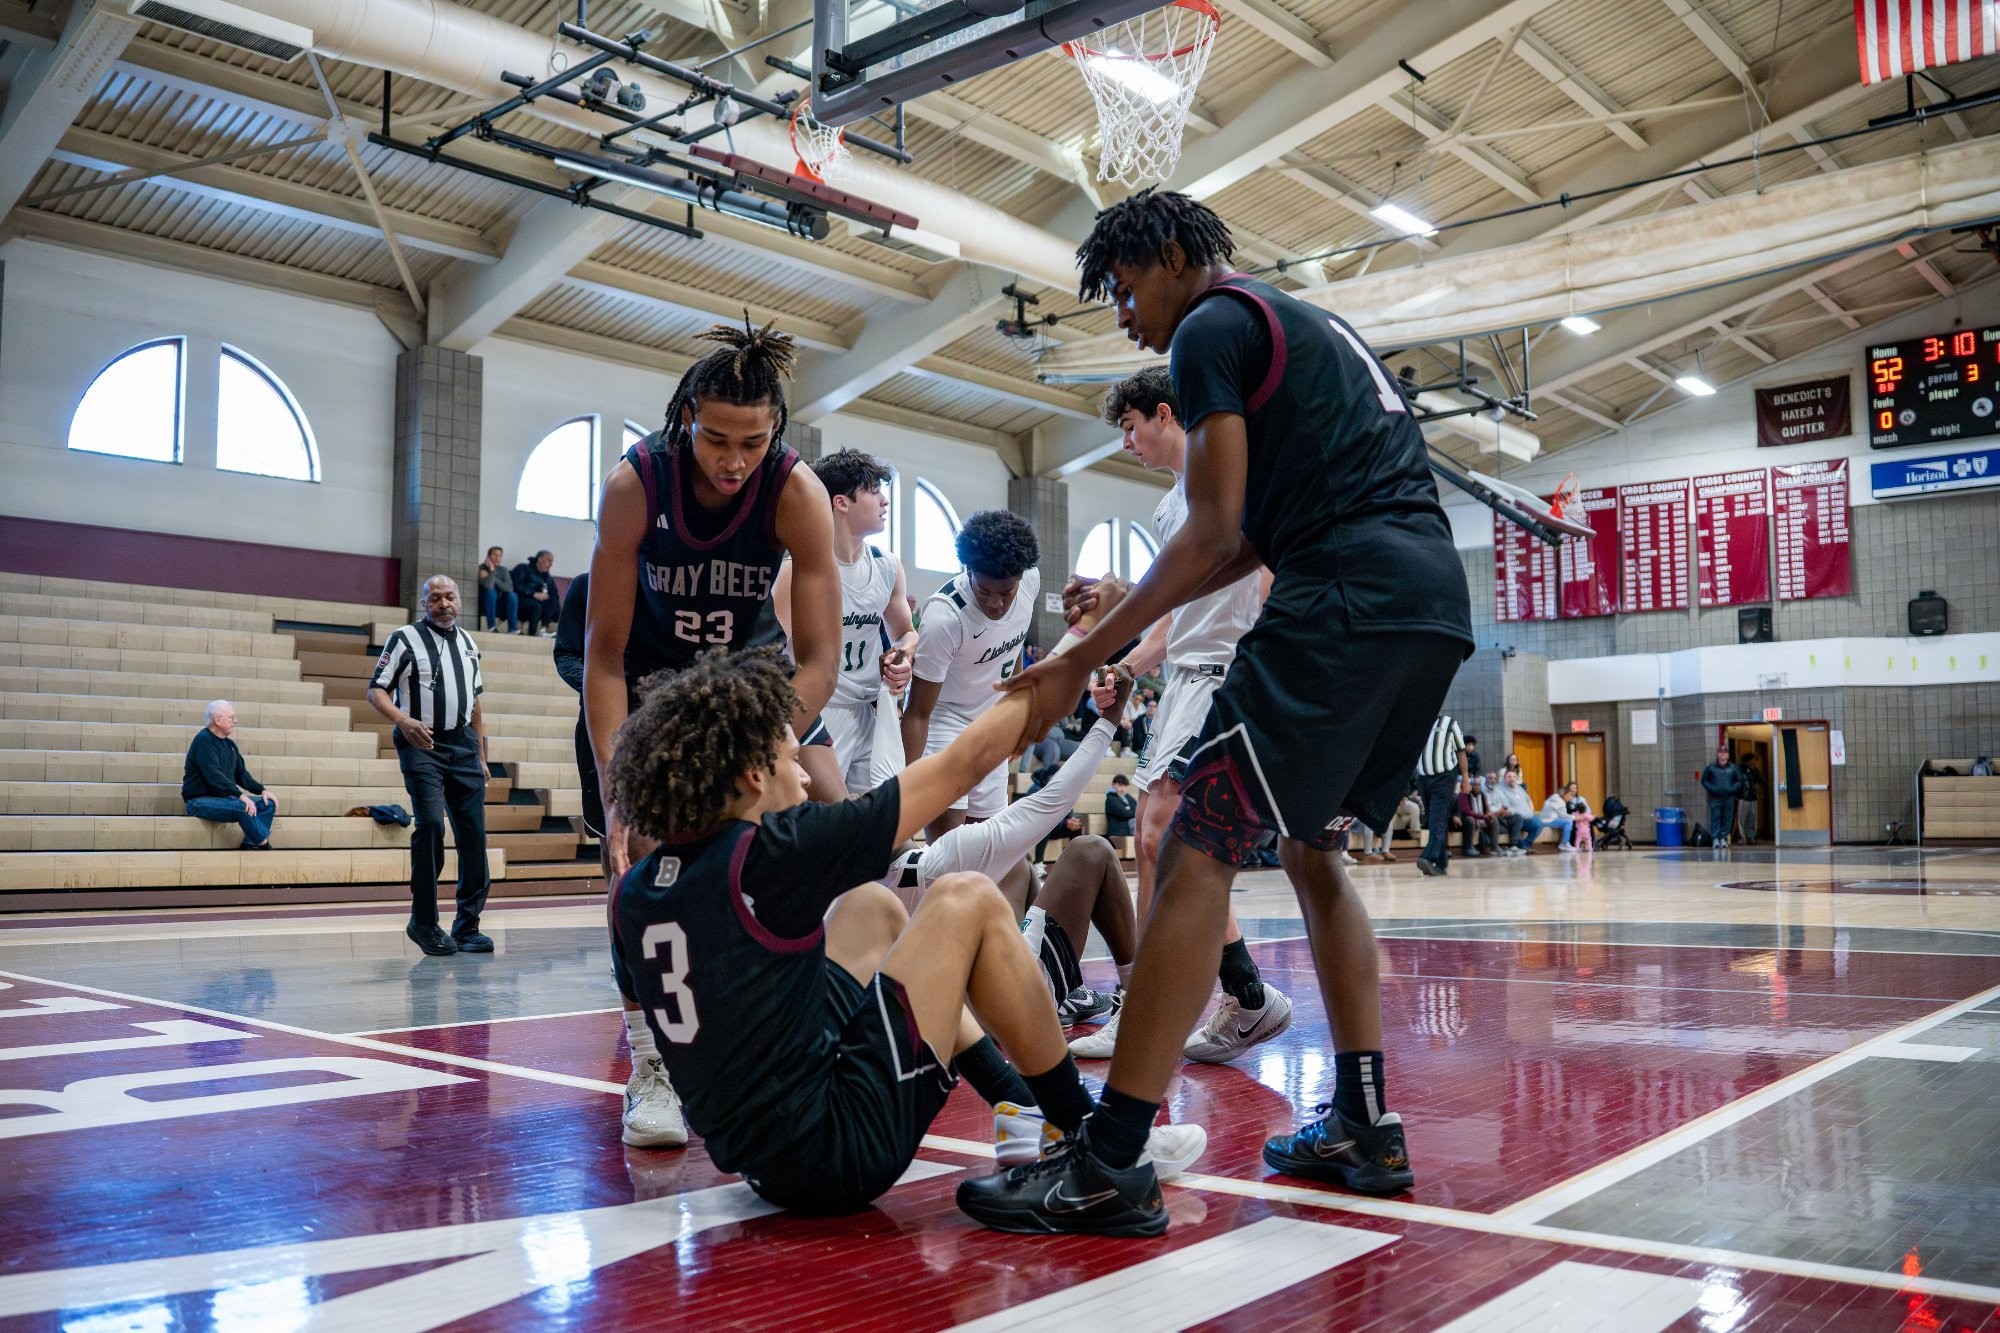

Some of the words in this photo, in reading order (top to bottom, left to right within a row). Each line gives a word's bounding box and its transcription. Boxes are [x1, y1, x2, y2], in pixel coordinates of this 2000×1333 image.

[1872, 346, 1898, 359] Home
[1923, 331, 1975, 362] 3:10
[1327, 318, 1406, 412] 1
[1873, 357, 1903, 383] 52
[1966, 363, 1979, 382] 3
[1774, 386, 1832, 406] BENEDICT'S
[1928, 387, 1960, 402] player
[1782, 406, 1813, 422] HATES
[1816, 404, 1825, 416] A
[1881, 411, 1893, 429] 0
[1782, 421, 1825, 438] QUITTER
[1930, 423, 1961, 438] weight
[1695, 475, 1724, 488] CROSS
[1725, 470, 1765, 484] COUNTRY
[1905, 470, 1949, 484] Horizon
[1621, 484, 1649, 496] CROSS
[1650, 480, 1689, 493] COUNTRY
[1625, 490, 1686, 506] CHAMPIONSHIPS
[646, 562, 704, 597] GRAY
[710, 559, 771, 601] BEES
[674, 609, 734, 644] 23
[844, 640, 866, 672] 11
[653, 856, 682, 887] B
[641, 921, 700, 1044] 3
